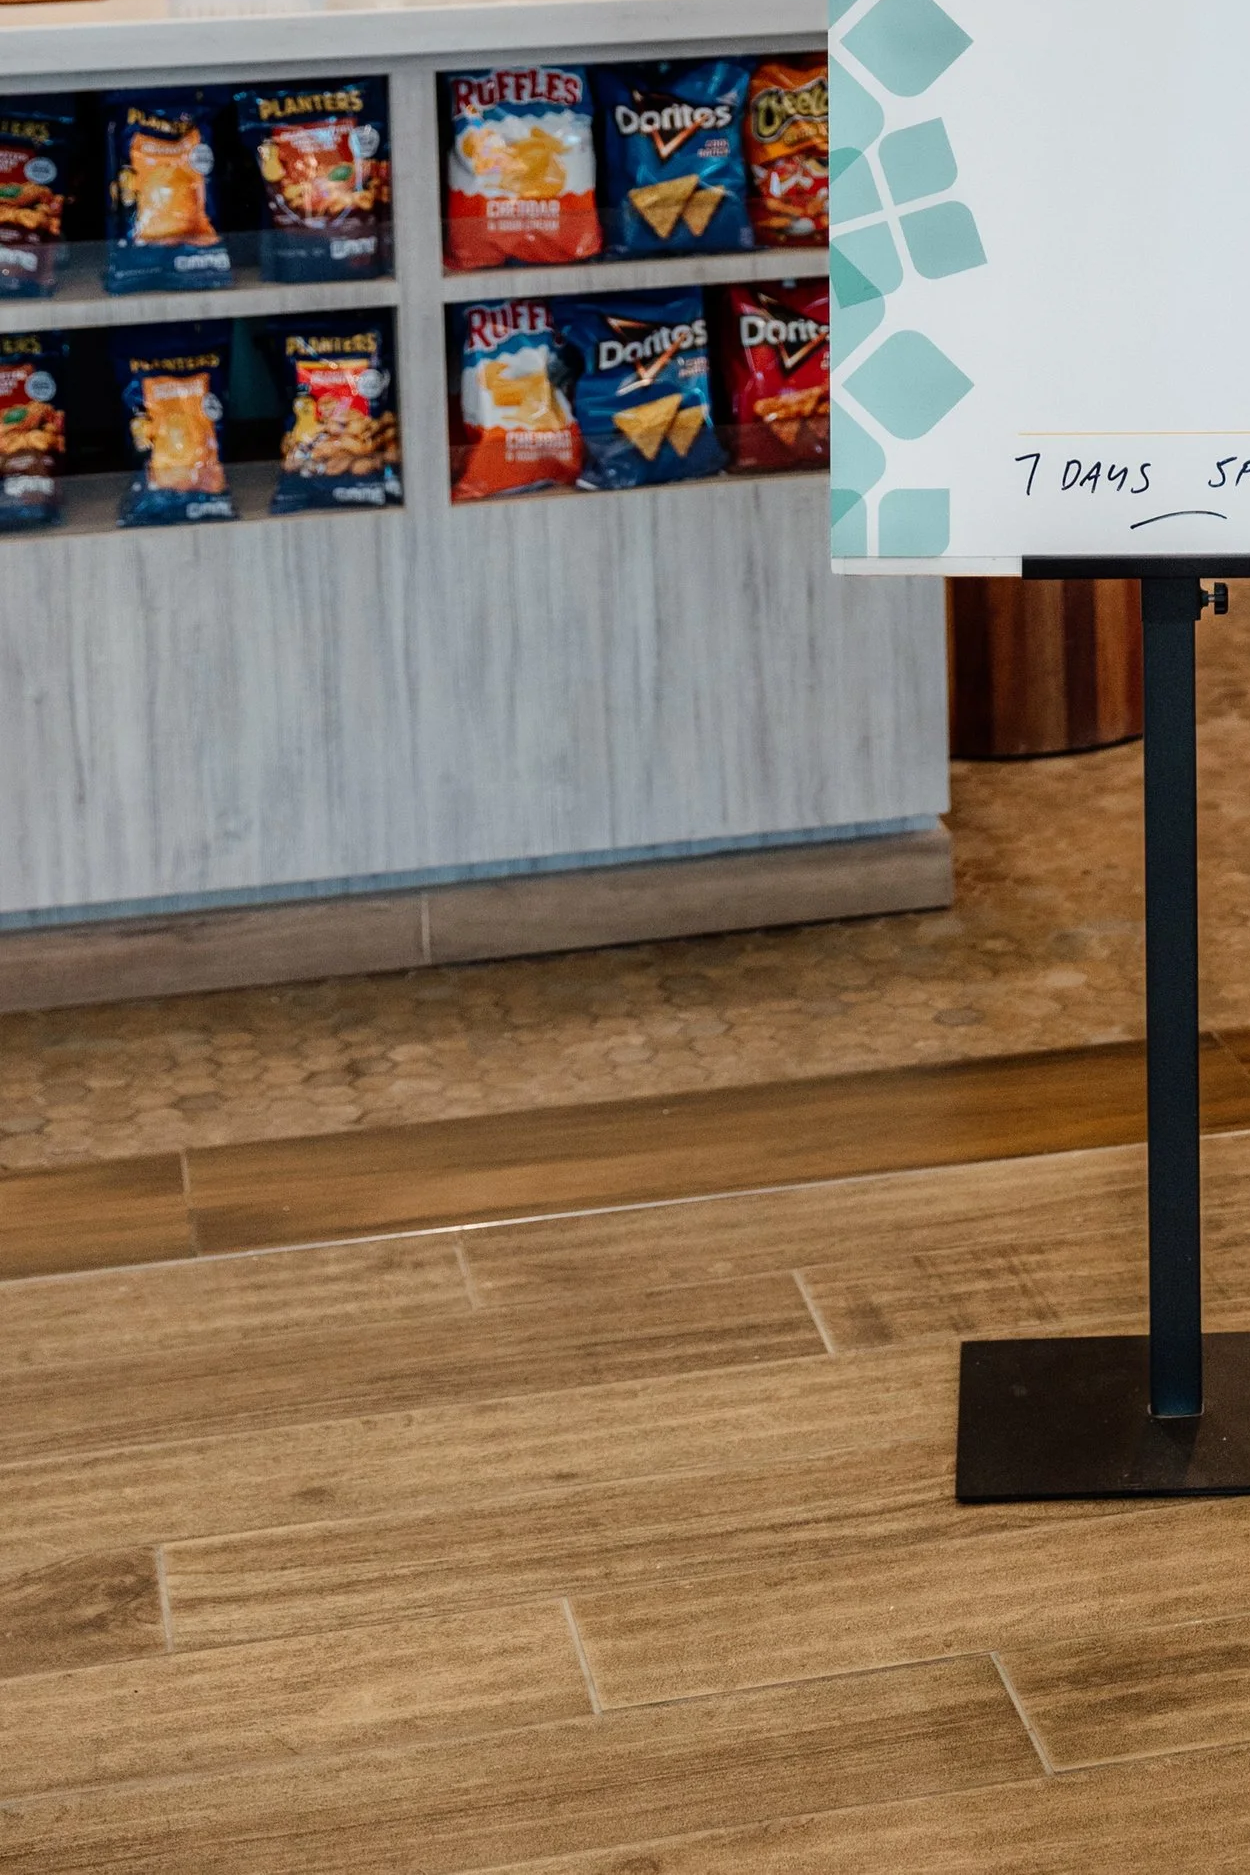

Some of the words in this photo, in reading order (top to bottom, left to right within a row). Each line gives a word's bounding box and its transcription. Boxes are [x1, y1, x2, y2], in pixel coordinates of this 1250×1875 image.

[259, 90, 364, 121] PLANTERS
[452, 68, 582, 116] RUFFLES
[615, 103, 732, 135] Doritos
[599, 320, 709, 371] Doritos
[1015, 452, 1041, 496] 7
[1061, 459, 1152, 494] DAYS
